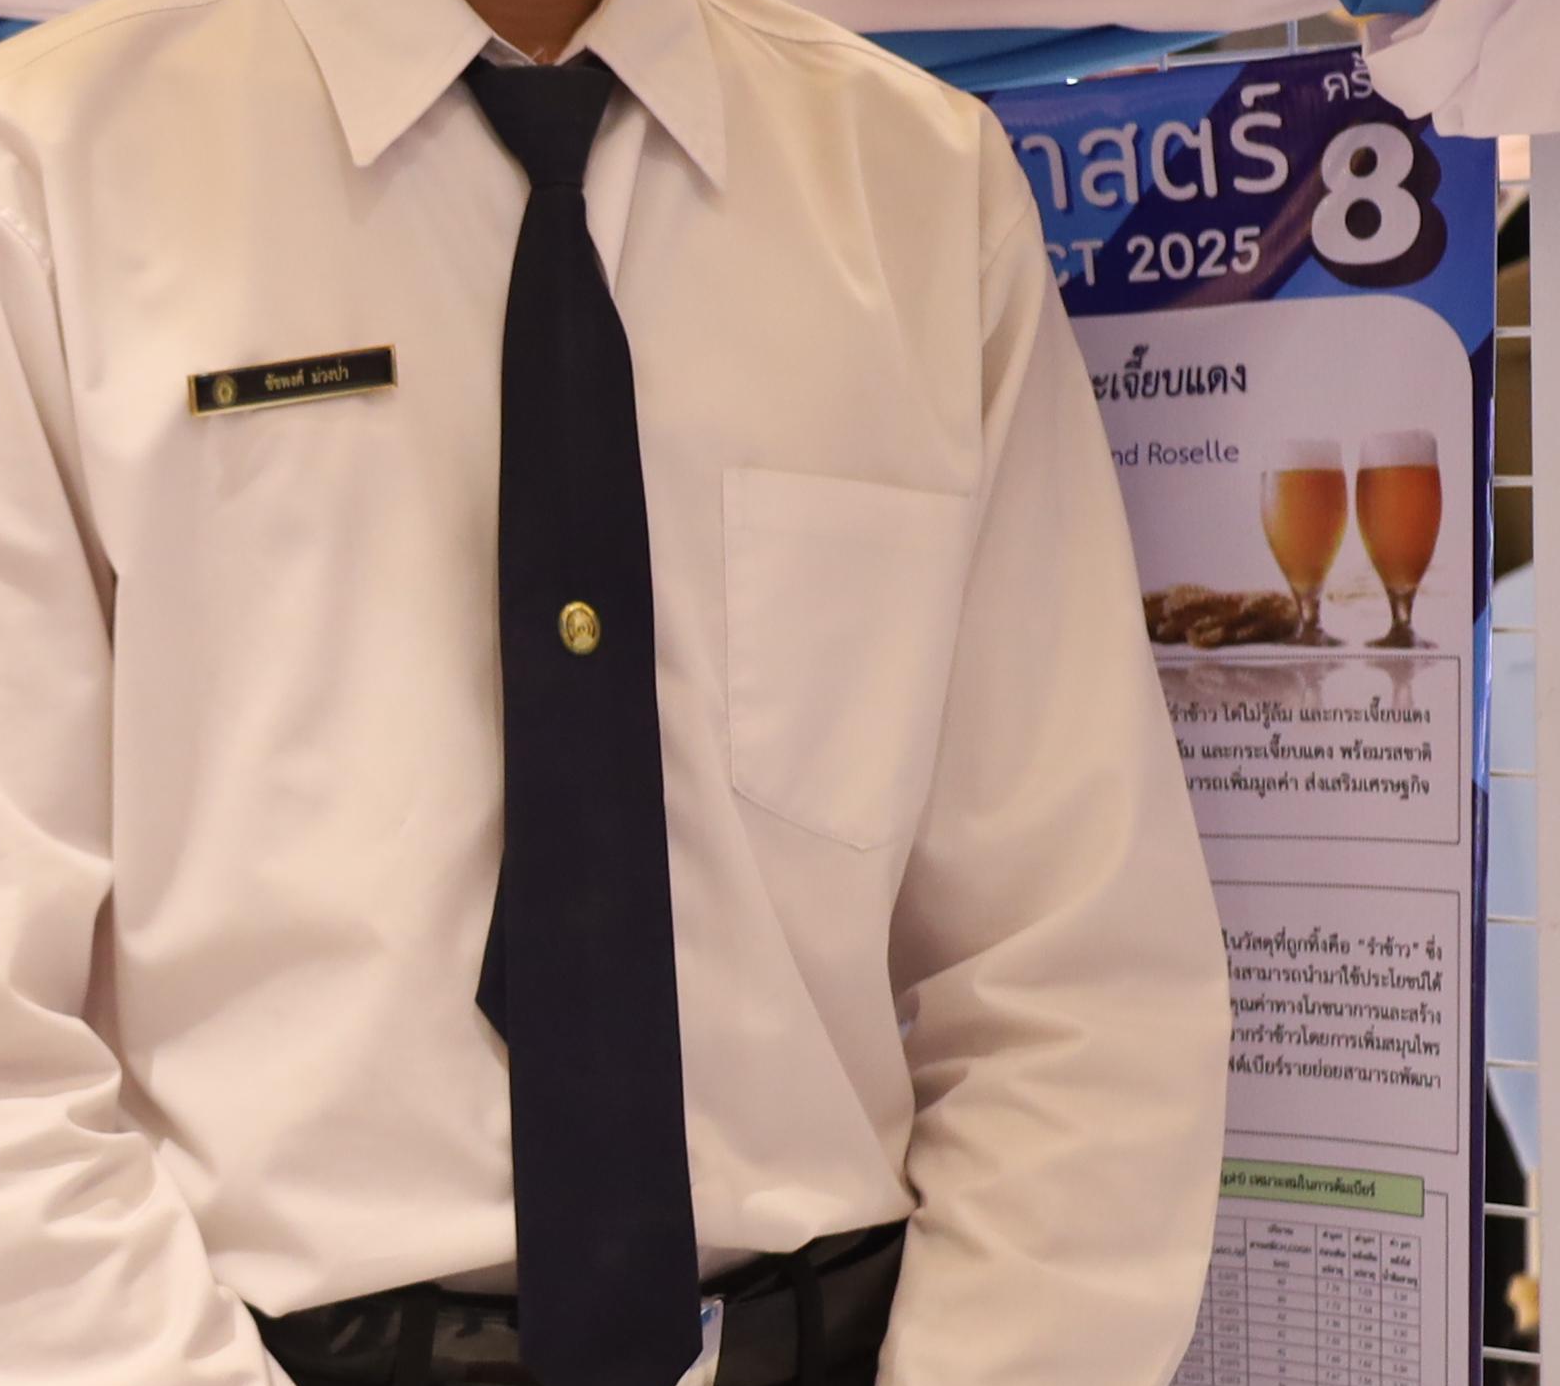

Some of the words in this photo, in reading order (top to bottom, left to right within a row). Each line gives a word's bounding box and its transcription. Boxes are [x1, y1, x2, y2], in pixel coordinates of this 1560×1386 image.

[1018, 81, 1289, 213] าสตร์
[1310, 122, 1421, 266] 8
[1126, 226, 1261, 283] 2025
[1148, 442, 1240, 466] Roselle
